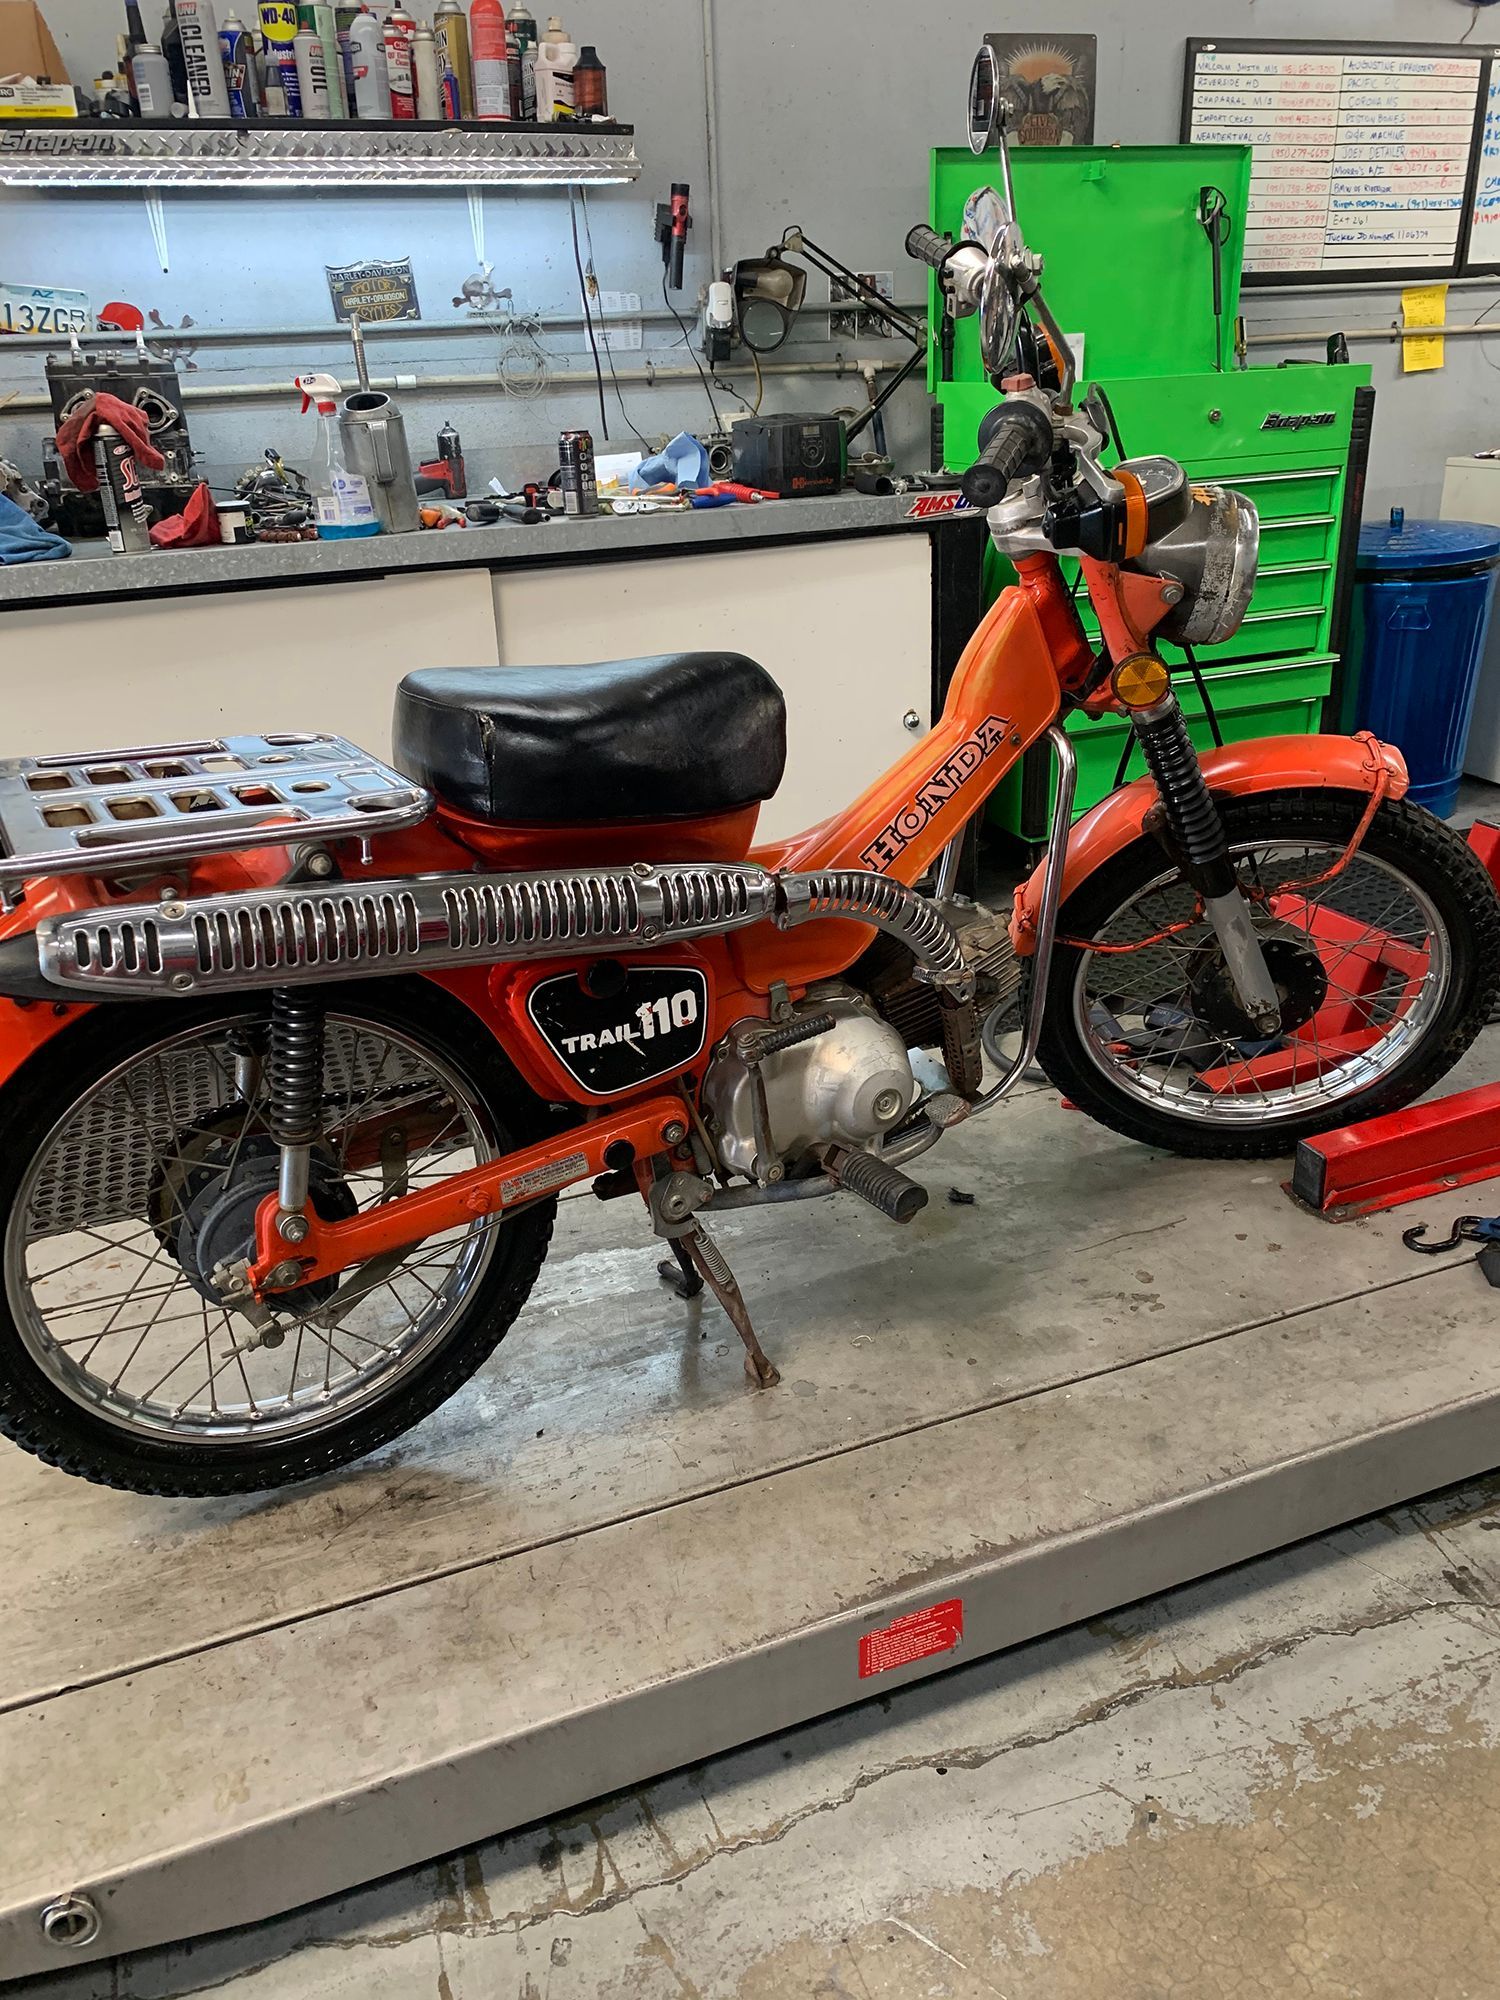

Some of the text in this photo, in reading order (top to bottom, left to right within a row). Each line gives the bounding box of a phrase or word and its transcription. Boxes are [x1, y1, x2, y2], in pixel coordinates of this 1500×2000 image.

[261, 7, 296, 25] WD-40
[180, 24, 211, 97] CLEANER
[1197, 77, 1241, 87] RIVERSIDE
[1197, 96, 1247, 106] CHAPARRAL
[0, 129, 113, 156] Snap-on
[1370, 130, 1406, 140] MACHINE
[31, 289, 55, 299] AZ
[344, 292, 406, 307] HARLEY-DAVIDSON
[1260, 411, 1337, 432] Snap-on
[858, 714, 1018, 874] HONDA
[561, 988, 698, 1054] TRAIL 110
